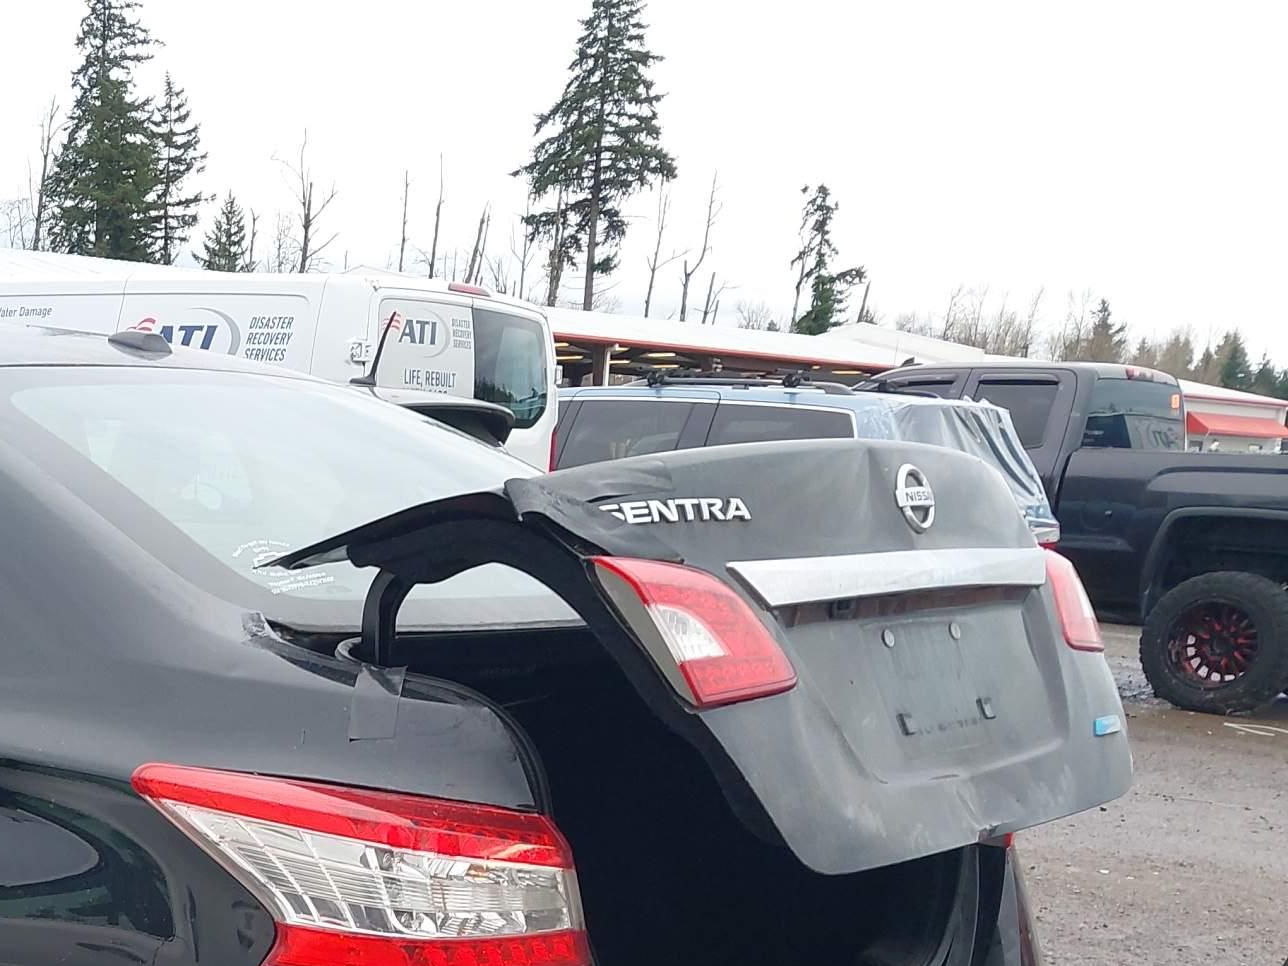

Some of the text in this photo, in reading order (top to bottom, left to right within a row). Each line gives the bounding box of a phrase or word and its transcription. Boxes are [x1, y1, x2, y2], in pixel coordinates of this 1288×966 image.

[19, 306, 52, 319] Damage
[249, 316, 294, 330] DISASTER
[246, 332, 293, 346] RECOVERY
[399, 319, 437, 345] ATI
[244, 348, 287, 362] SERVICES
[404, 368, 457, 388] LIFE, REBUILT
[598, 497, 753, 525] SENTRA
